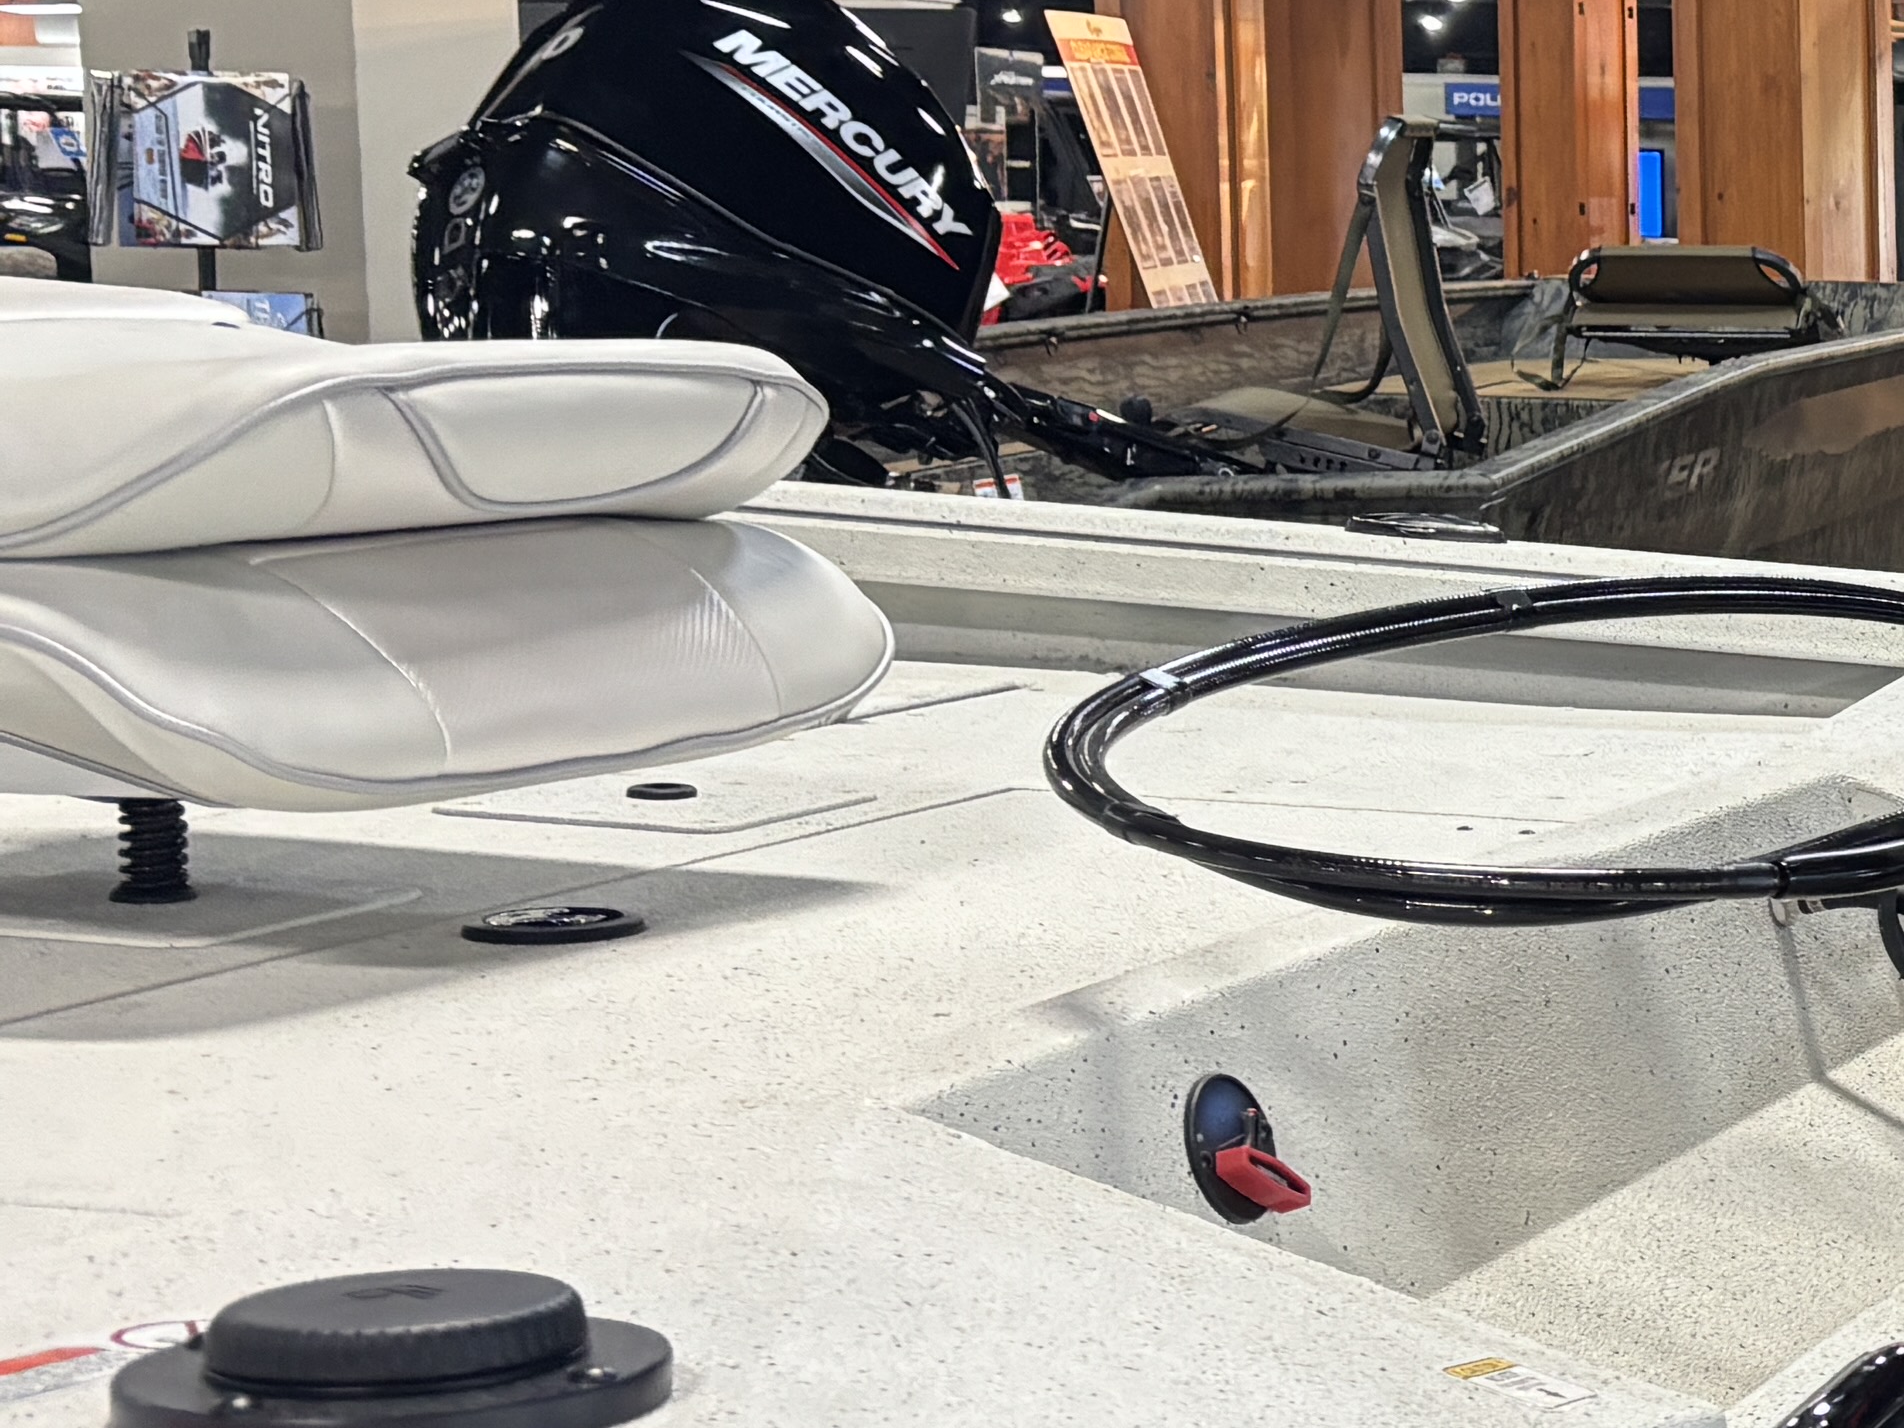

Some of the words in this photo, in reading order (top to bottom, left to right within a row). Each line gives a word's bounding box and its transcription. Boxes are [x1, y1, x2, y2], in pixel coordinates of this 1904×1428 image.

[713, 28, 974, 236] MERCURY
[1453, 90, 1500, 107] POL
[252, 106, 275, 209] NITRO
